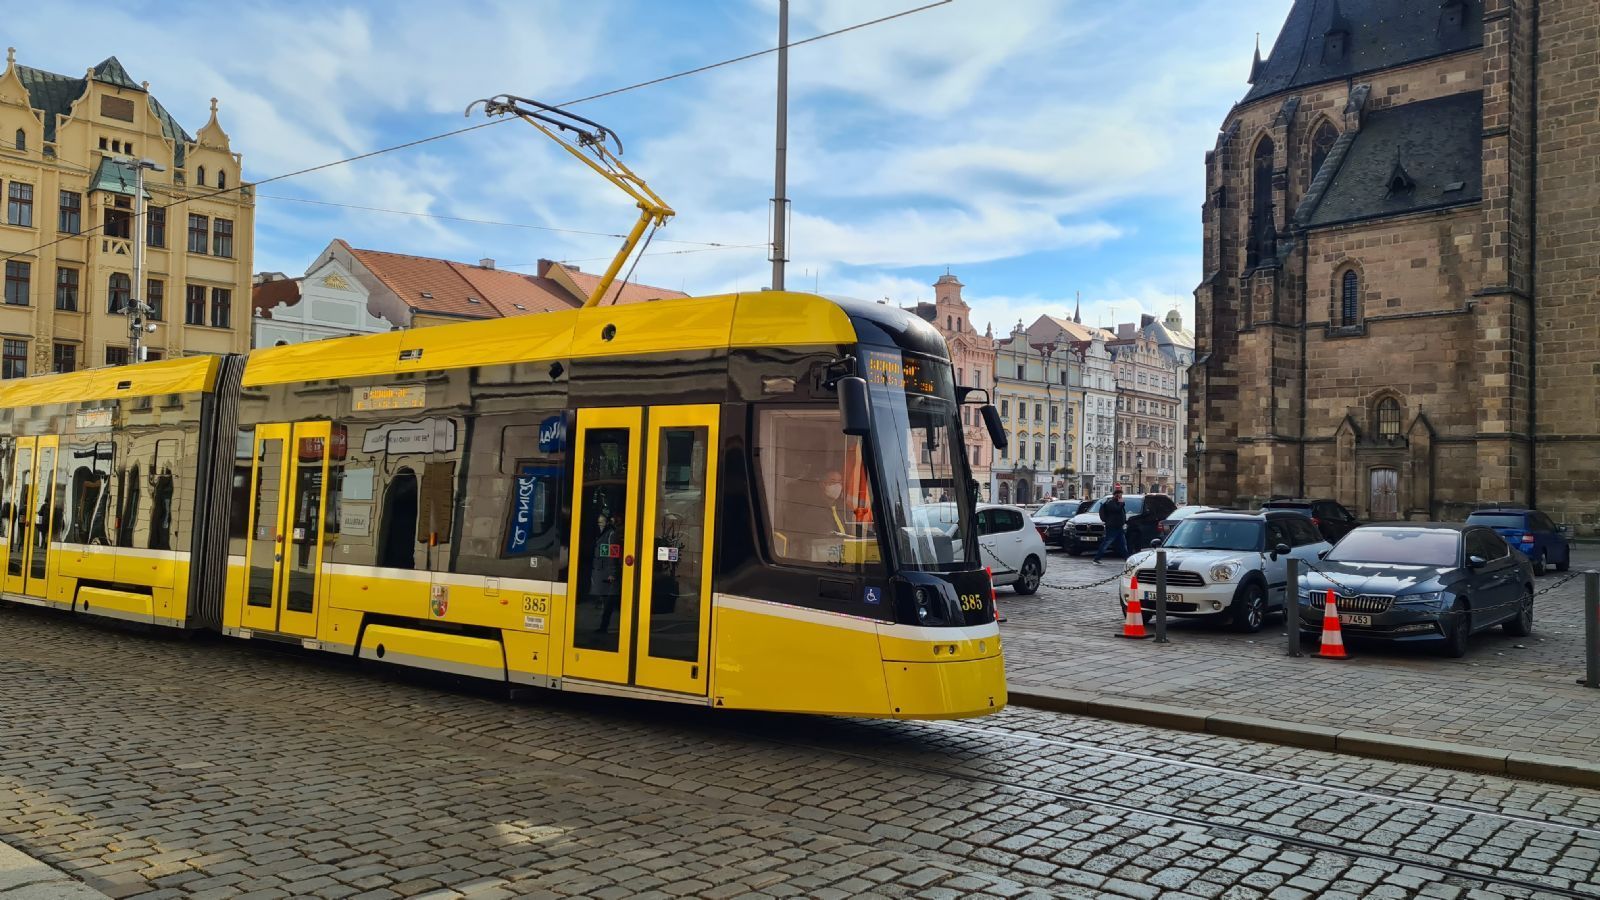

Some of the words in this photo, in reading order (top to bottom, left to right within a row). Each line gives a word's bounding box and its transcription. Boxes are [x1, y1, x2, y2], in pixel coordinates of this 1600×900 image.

[524, 596, 546, 612] 385
[961, 594, 983, 611] 385
[1348, 615, 1368, 625] 7453
